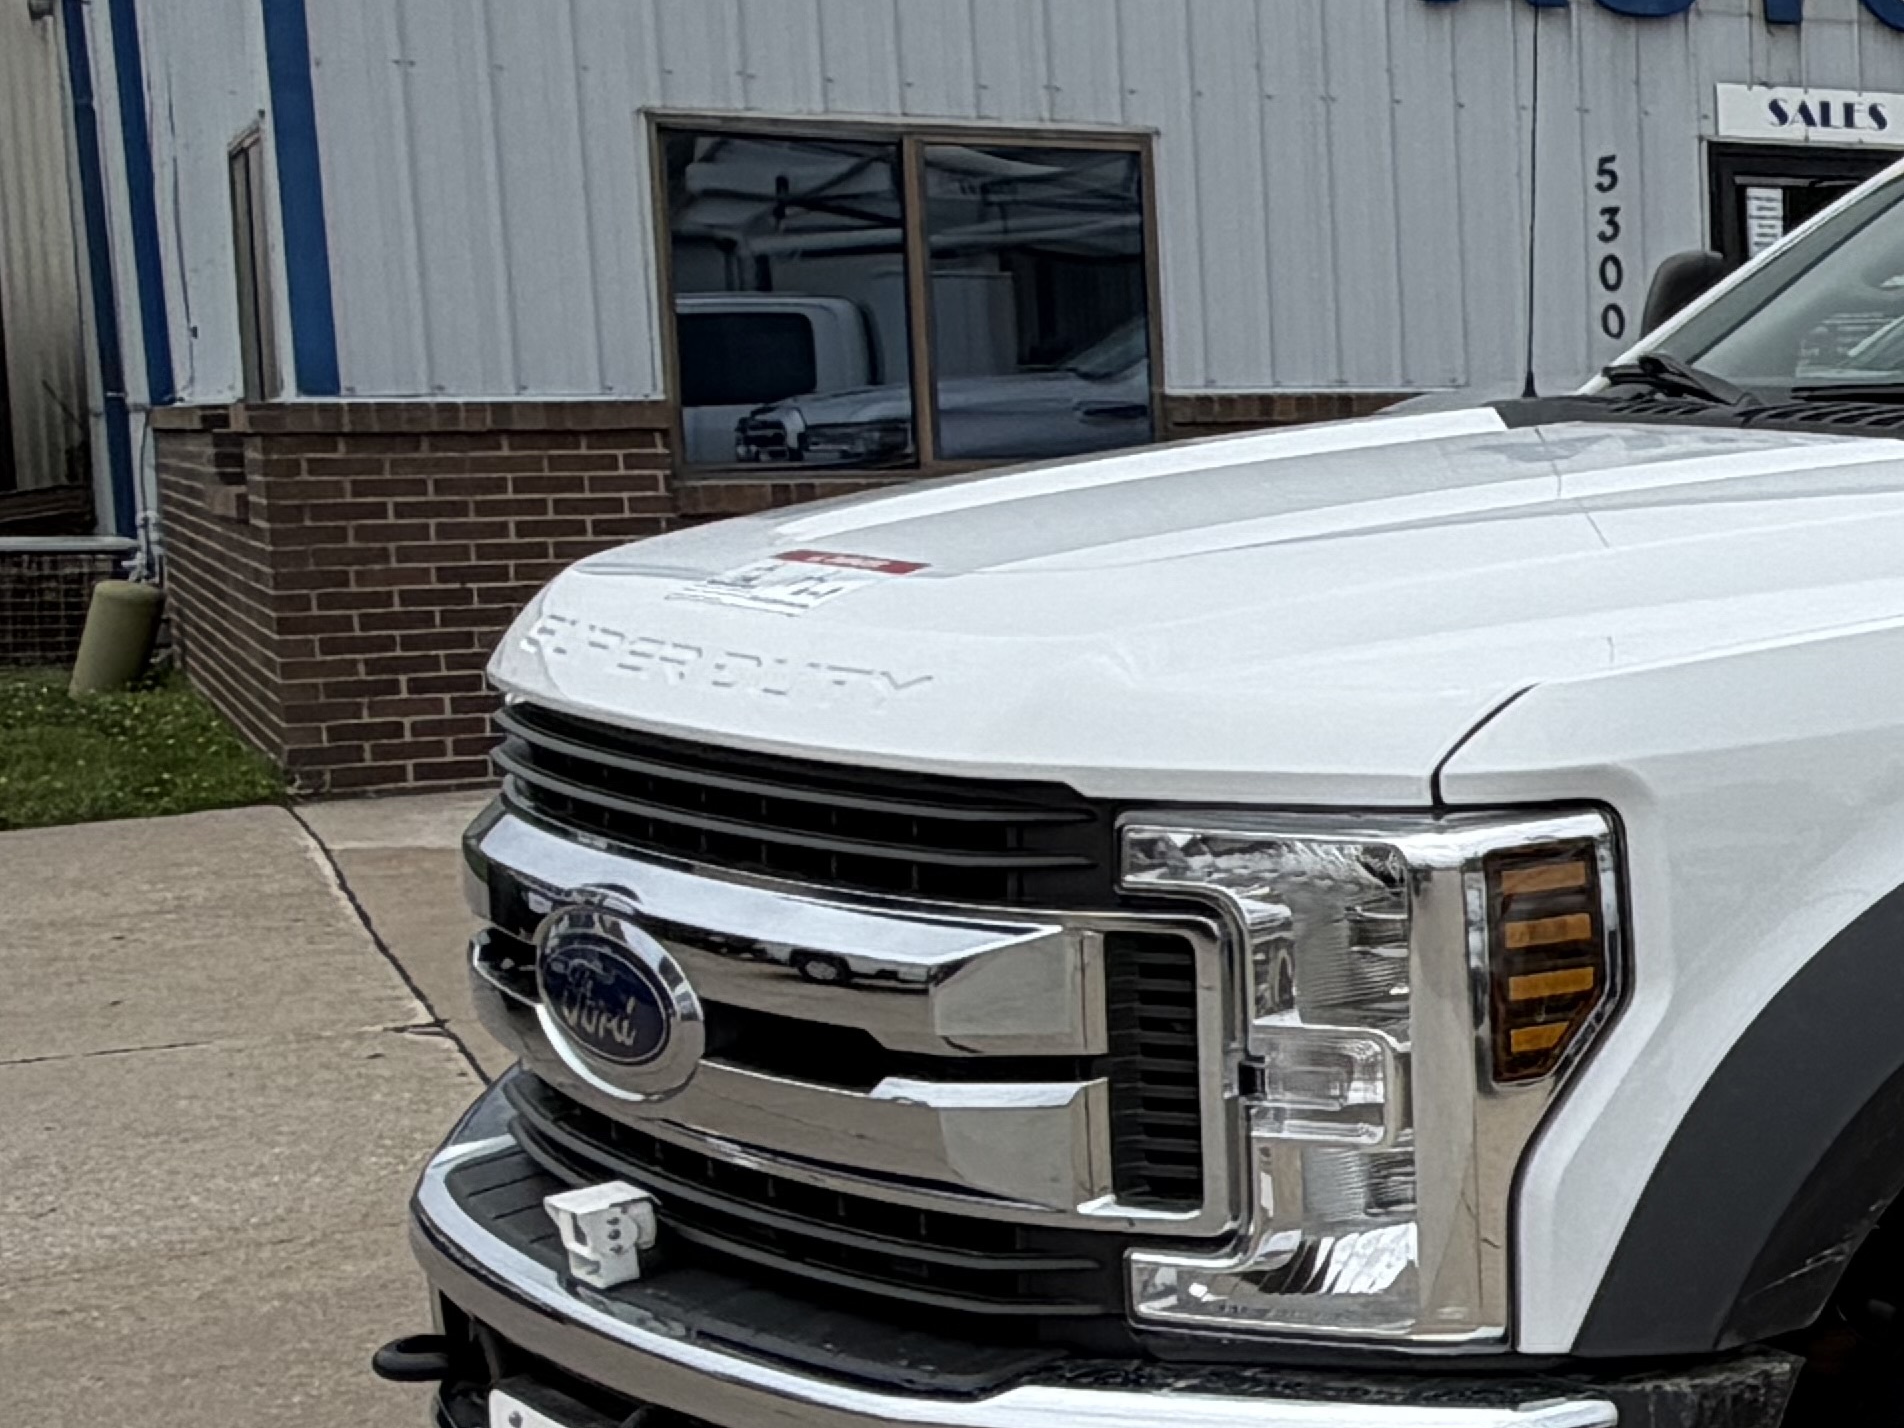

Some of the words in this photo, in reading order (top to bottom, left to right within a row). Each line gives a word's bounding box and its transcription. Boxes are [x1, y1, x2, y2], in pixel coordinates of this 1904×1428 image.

[1767, 97, 1889, 132] SALES
[1594, 154, 1626, 340] 5300
[519, 613, 704, 685] SUPER
[709, 650, 935, 711] DUTY
[547, 956, 641, 1046] Ford
